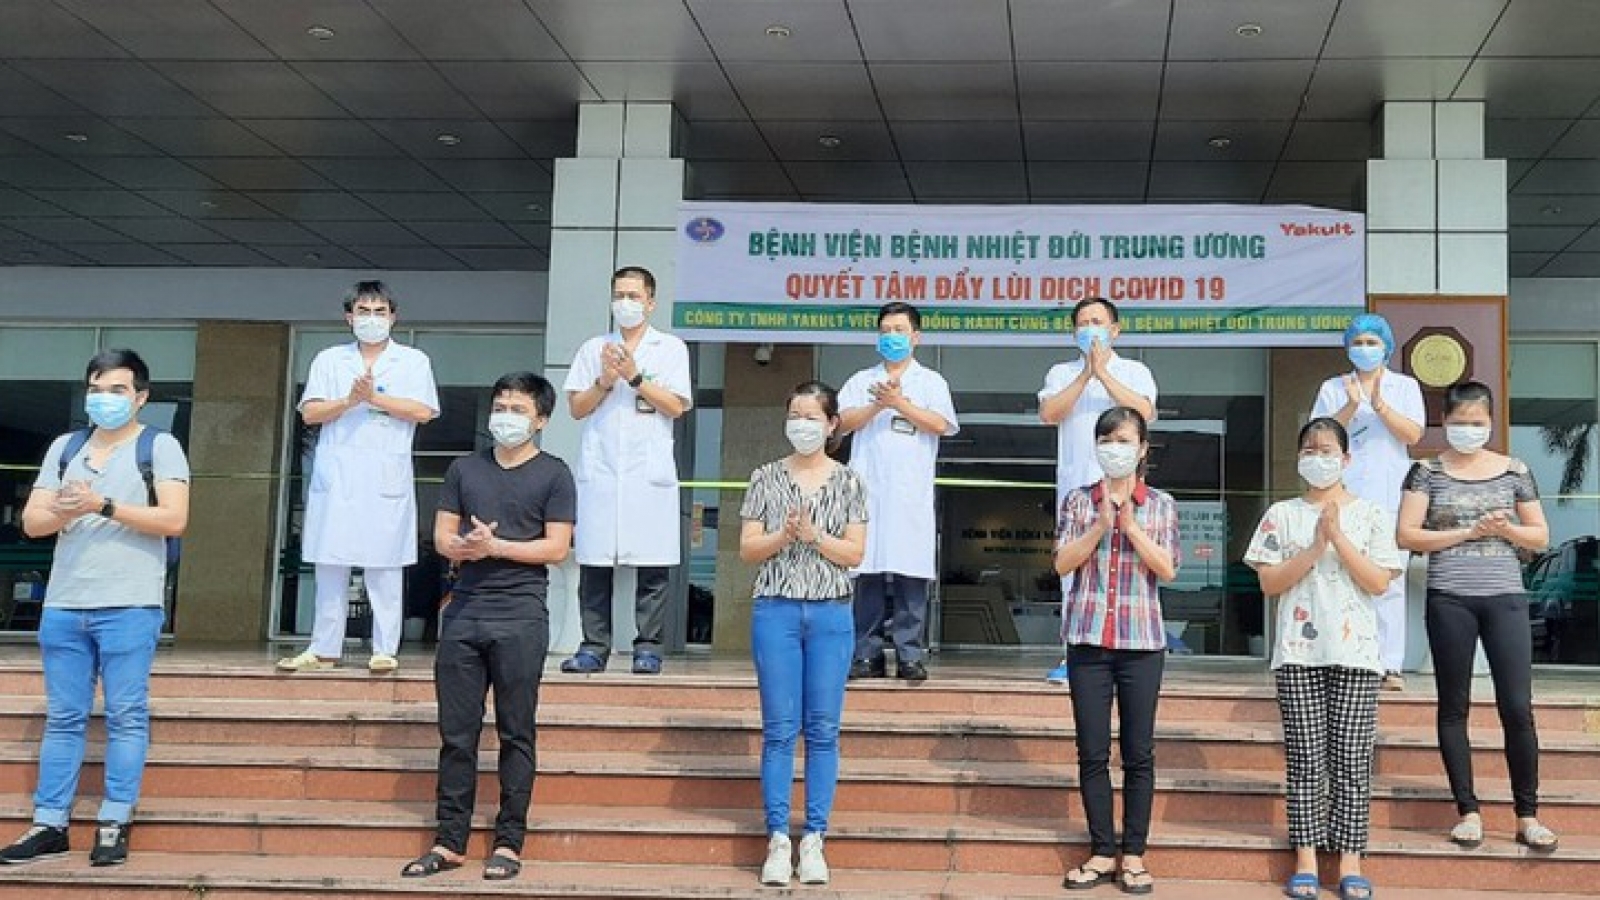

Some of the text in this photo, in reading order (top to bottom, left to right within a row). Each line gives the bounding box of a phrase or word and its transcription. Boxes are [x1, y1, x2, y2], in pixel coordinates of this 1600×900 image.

[1280, 222, 1355, 236] Yakult
[749, 228, 1266, 265] BỆNH VIỆN BỆNH NHIỆT ĐỚI TRUNG ƯƠNG
[785, 266, 865, 300] QUYẾT
[873, 270, 927, 300] TÂM
[935, 266, 985, 300] ĐẨY
[993, 271, 1031, 301] LÙI
[1040, 277, 1101, 305] DỊCH
[1194, 276, 1226, 301] 19
[684, 309, 723, 325] CÔNG
[728, 312, 745, 326] TY
[749, 312, 787, 326] TNHH
[792, 313, 845, 328] YAKULT
[1179, 311, 1221, 332] NHIỆT
[1258, 314, 1306, 330] TRUNG
